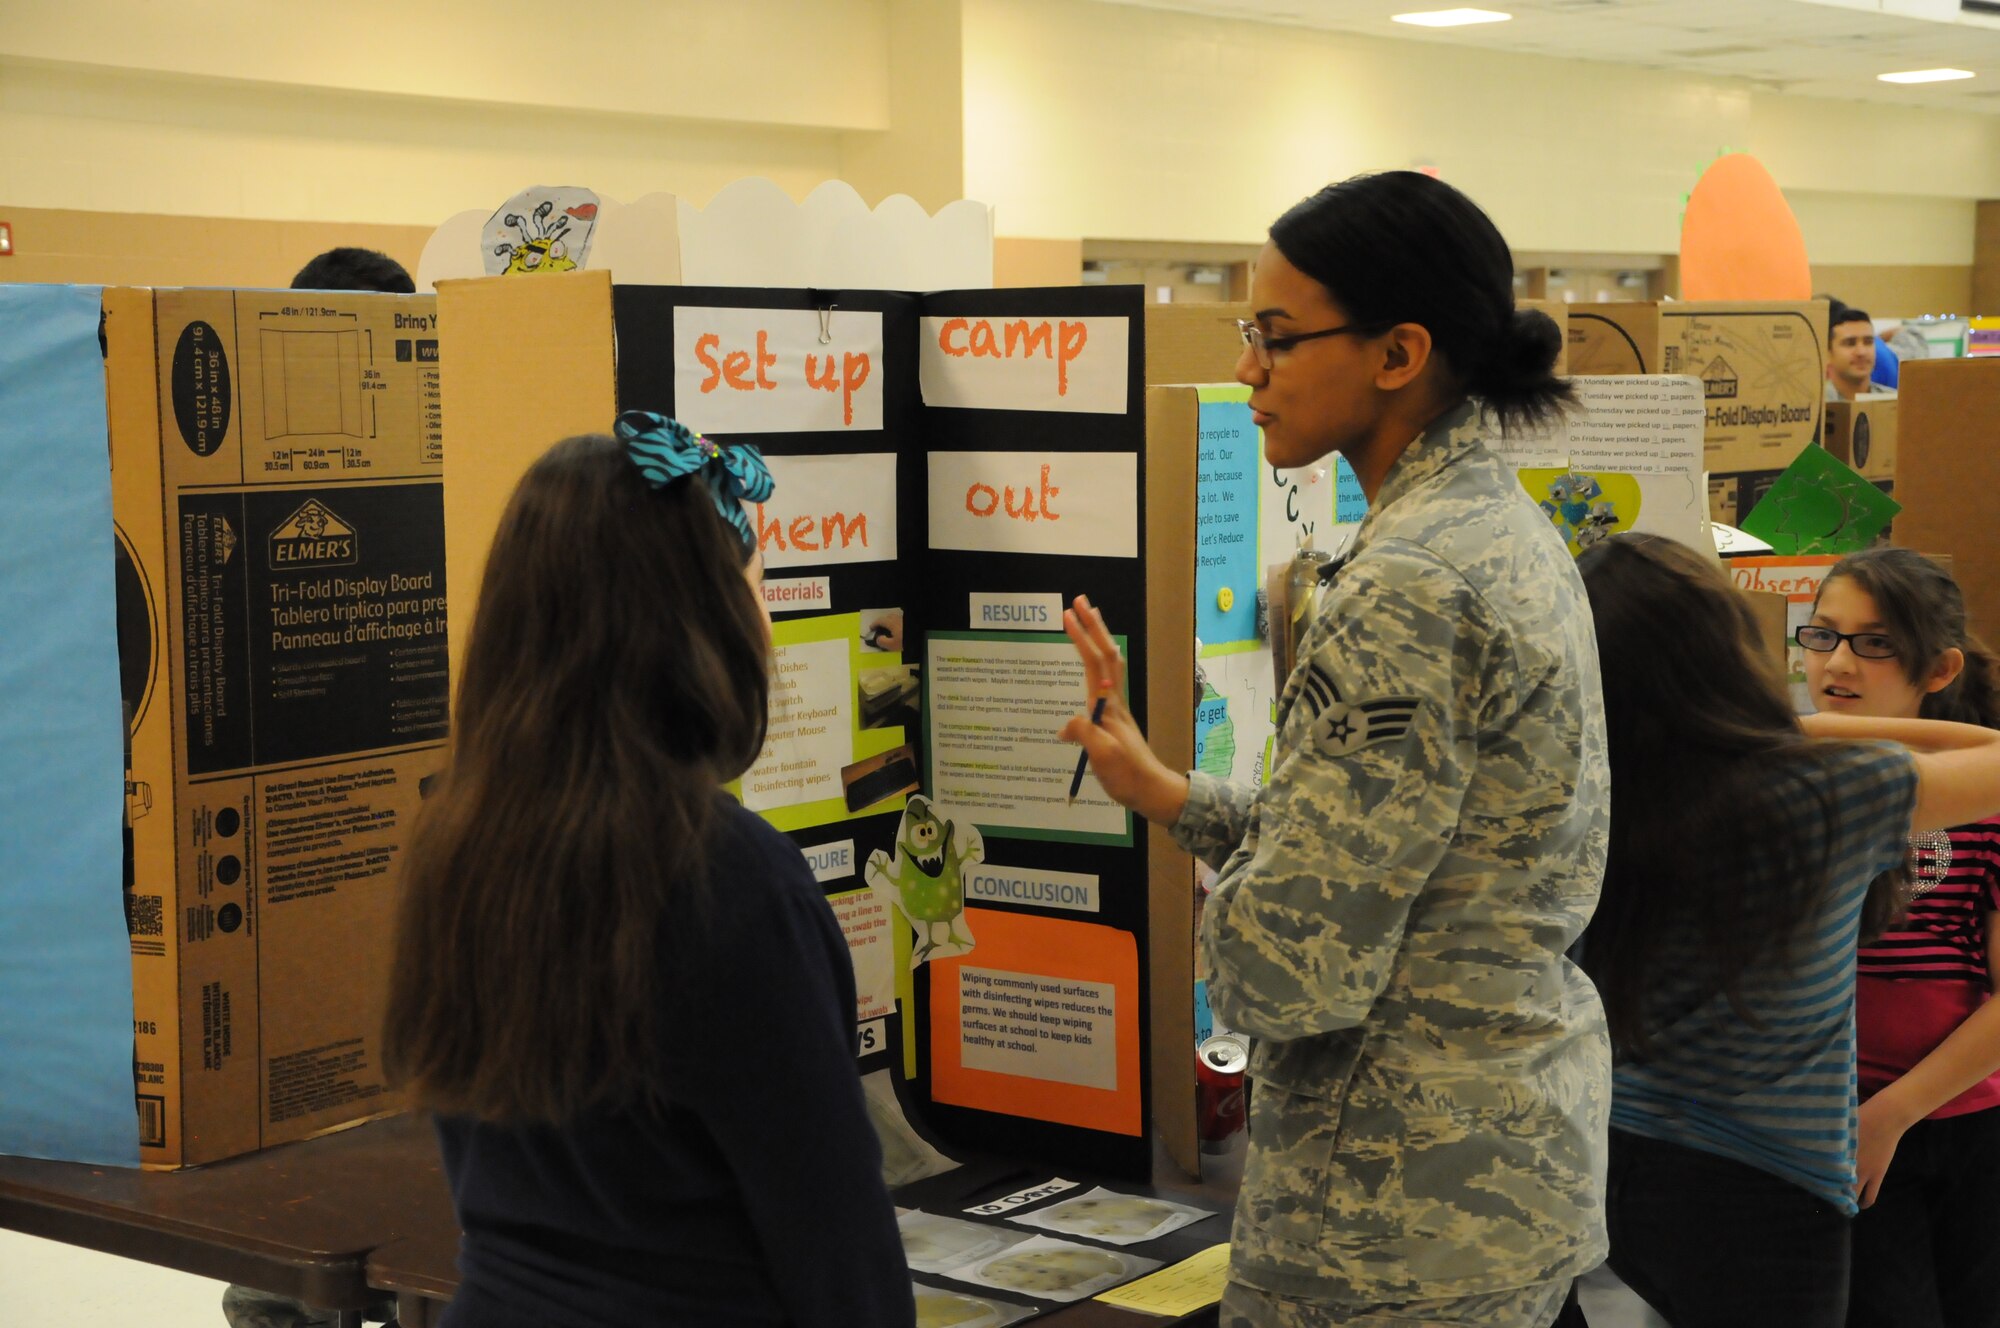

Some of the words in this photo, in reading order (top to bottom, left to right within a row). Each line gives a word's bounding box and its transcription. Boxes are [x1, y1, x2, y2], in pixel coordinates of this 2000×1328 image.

[394, 313, 428, 331] Bring
[209, 350, 219, 367] 36
[939, 318, 1087, 396] camp
[695, 330, 777, 393] Set
[805, 351, 870, 426] up
[1626, 379, 1649, 387] picked
[211, 397, 222, 414] 48
[1637, 407, 1660, 415] picked
[1739, 404, 1777, 427] Display
[1780, 402, 1811, 423] Board
[1582, 420, 1614, 429] Thursday
[1627, 421, 1650, 429] picked
[1206, 427, 1231, 441] recycle
[1232, 429, 1240, 438] to
[1582, 435, 1603, 443] Friday
[1616, 435, 1639, 443] picked
[1200, 449, 1217, 461] orld.
[1219, 448, 1233, 460] Our
[1581, 449, 1612, 457] Saturday
[1214, 470, 1243, 482] because
[1620, 464, 1642, 472] picked
[966, 463, 1060, 521] out
[1208, 491, 1219, 503] lot.
[1222, 491, 1234, 502] We
[1339, 493, 1351, 503] the
[1214, 514, 1222, 523] to
[1223, 512, 1240, 523] save
[1338, 512, 1352, 523] and
[757, 503, 868, 551] hem
[197, 512, 208, 562] Tablero
[1201, 534, 1217, 546] Let's
[1218, 532, 1244, 544] Reduce
[276, 540, 351, 562] ELMER'S
[1200, 554, 1227, 568] Recycle
[271, 579, 330, 603] Tri-Fold
[334, 576, 388, 598] Display
[390, 571, 432, 592] Board
[212, 574, 224, 624] Tri-Fold
[271, 606, 329, 627] Tablero
[387, 600, 419, 619] para
[982, 604, 1047, 622] RESULTS
[272, 630, 340, 652] Panneau
[343, 622, 421, 644] d'affichage
[213, 627, 225, 674] Display
[780, 662, 808, 673] Dishes
[216, 677, 227, 717] Board
[769, 713, 795, 726] puter
[797, 706, 837, 720] Keyboard
[1208, 705, 1226, 725] get
[797, 726, 827, 736] Mouse
[760, 748, 773, 759] esk
[780, 759, 816, 772] fountain
[806, 773, 831, 785] wipes
[973, 876, 1088, 905] CONCLUSION
[962, 972, 992, 987] Wiping
[993, 978, 1038, 993] commonly
[1040, 984, 1061, 994] used
[1063, 986, 1099, 999] surfaces
[962, 988, 981, 998] with
[983, 990, 1032, 1007] disinfecting
[1034, 997, 1059, 1010] wipes
[1062, 1001, 1096, 1014] reduces
[1098, 1005, 1113, 1017] the
[962, 1005, 991, 1015] germs.
[993, 1007, 1007, 1018] We
[1009, 1009, 1037, 1022] should
[1040, 1013, 1061, 1027] keep
[1063, 1017, 1093, 1032] wiping
[963, 1019, 997, 1032] surfaces
[999, 1025, 1008, 1033] at
[1010, 1025, 1037, 1037] school
[1040, 1029, 1049, 1039] to
[1051, 1030, 1072, 1044] keep
[1074, 1032, 1092, 1045] kids
[963, 1033, 995, 1049] healthy
[997, 1040, 1006, 1048] at
[1007, 1041, 1037, 1053] school.
